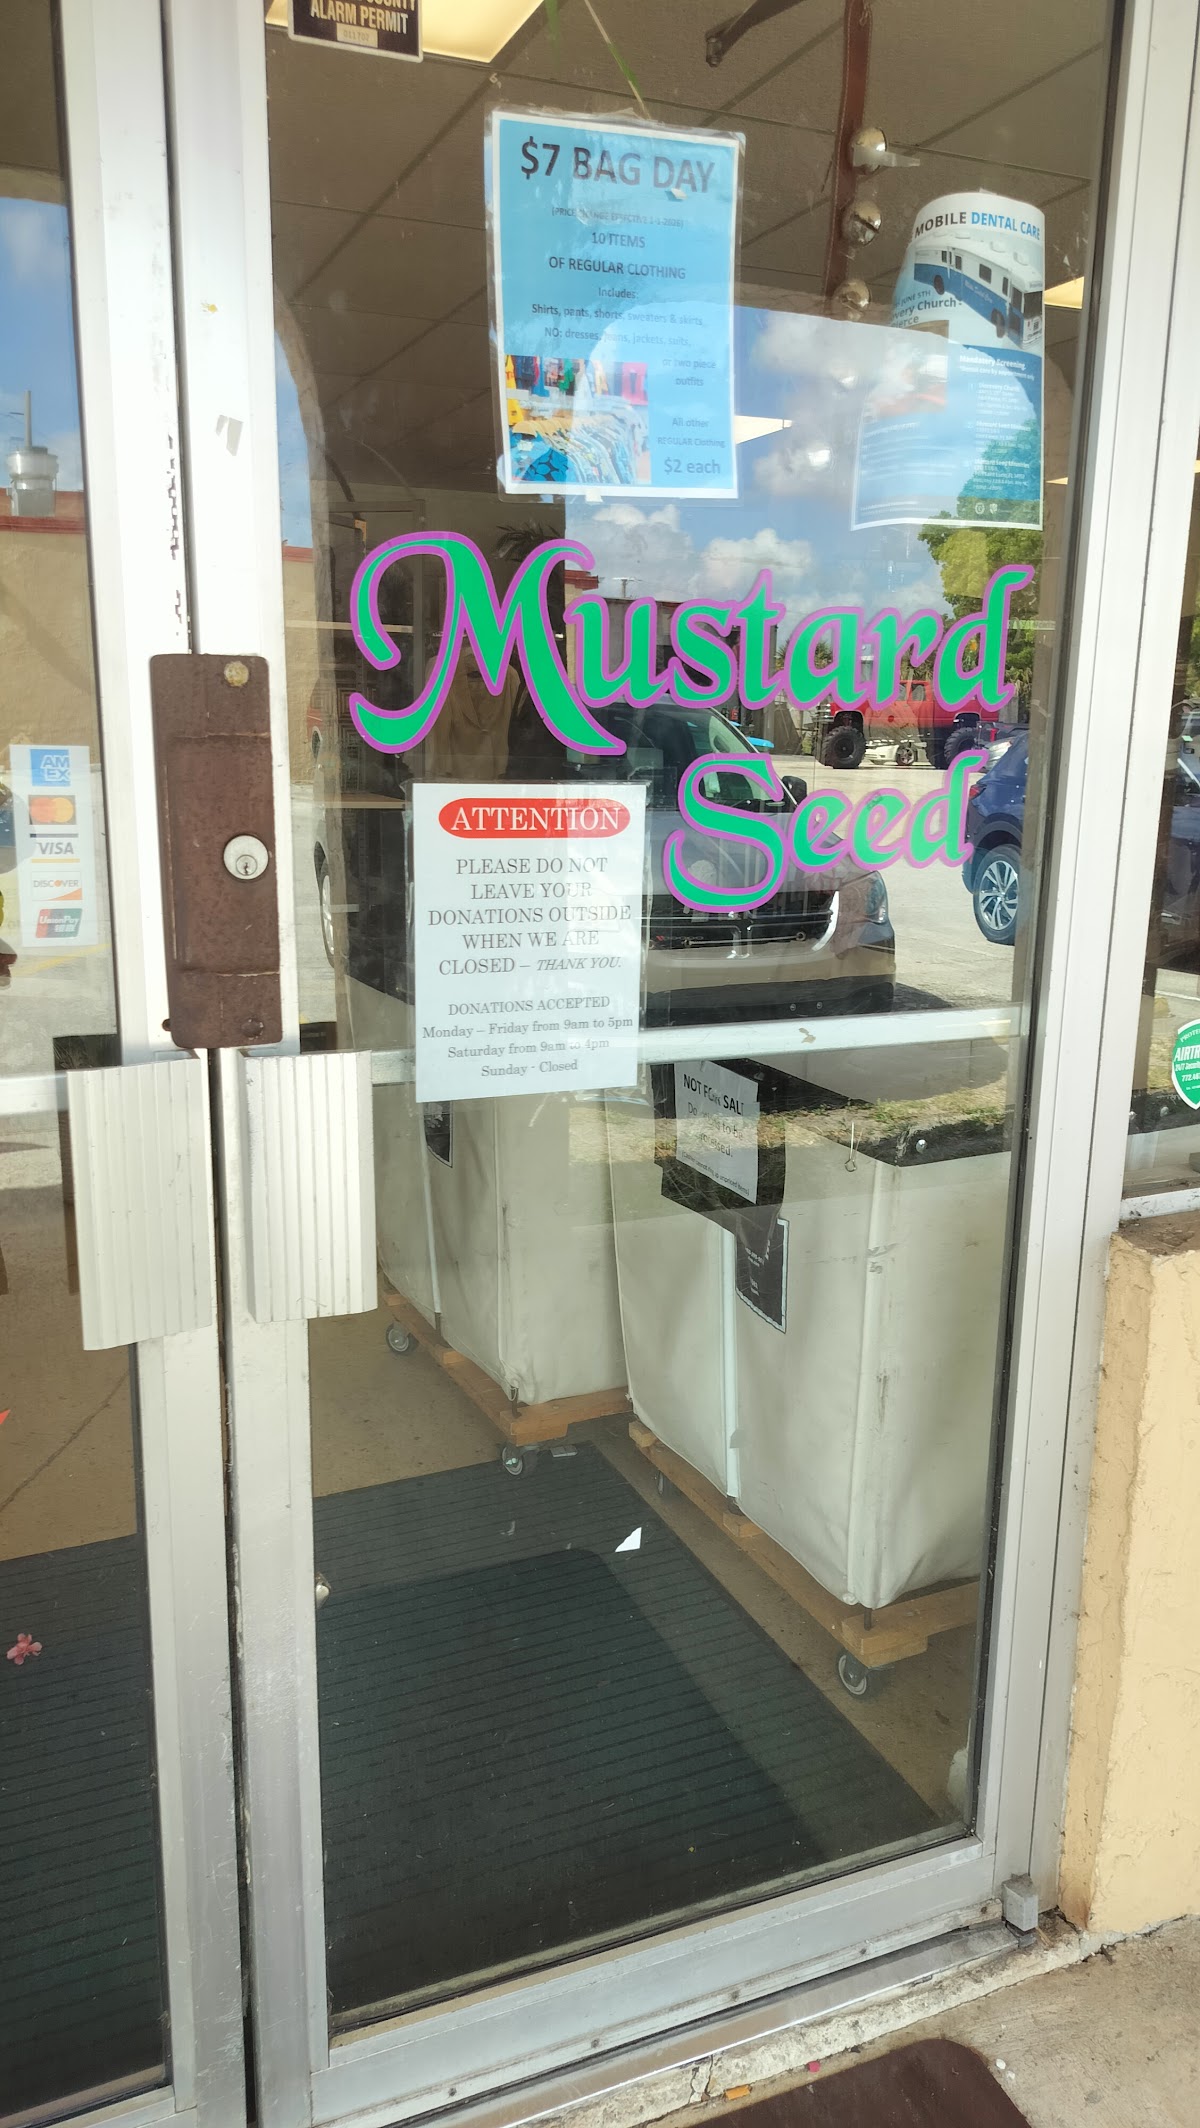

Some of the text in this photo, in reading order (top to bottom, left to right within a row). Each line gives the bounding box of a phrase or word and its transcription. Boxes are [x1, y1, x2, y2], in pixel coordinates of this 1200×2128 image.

[311, 0, 356, 25] ALARM
[360, 5, 408, 34] PERMIT
[520, 135, 715, 193] $7 BAG DAY
[914, 211, 1040, 241] MOBILE DENTAL CARE
[592, 231, 646, 249] 10 ITEMS
[549, 256, 686, 280] OF REGULAR CLOTHING
[598, 287, 639, 299] Includes:
[917, 297, 957, 311] Church
[532, 304, 561, 316] Shirts,
[564, 307, 592, 320] pants,
[594, 308, 626, 320] shorts,
[628, 312, 667, 323] sweaters
[669, 314, 677, 324] &
[544, 327, 562, 339] NO:
[565, 328, 602, 341] dresses,
[633, 333, 666, 345] jackets,
[675, 376, 704, 386] outfits
[672, 417, 709, 428] All other
[657, 436, 726, 449] REGULAR Clothing
[664, 456, 721, 475] $2 each
[350, 530, 1036, 757] Mustard
[41, 755, 70, 768] AM
[450, 807, 621, 831] ATTENTION
[662, 748, 990, 913] Seed
[38, 842, 74, 855] VISA
[456, 857, 608, 875] PLEASE DO NOT
[33, 880, 79, 888] DISCOVER
[471, 882, 592, 900] LEAVE YOUR
[39, 915, 80, 926] UnionPay
[428, 905, 632, 926] DONATIONS OUTSIDE
[462, 930, 600, 950] WHEN WE ARE
[439, 957, 515, 976] CLOSED
[536, 958, 586, 972] THANK
[591, 956, 622, 969] YOU.
[448, 996, 610, 1016] DONATIONS ACCEPTED
[422, 1025, 474, 1039] Monday
[488, 1023, 529, 1036] Friday
[532, 1020, 560, 1032] from
[564, 1019, 589, 1030] 9am
[593, 1018, 604, 1028] to
[608, 1017, 633, 1030] 5pm
[447, 1039, 610, 1059] Saturday from 9am to 4pm
[480, 1065, 528, 1078] Sunday
[539, 1059, 578, 1073] Closed
[683, 1074, 702, 1095] NOT
